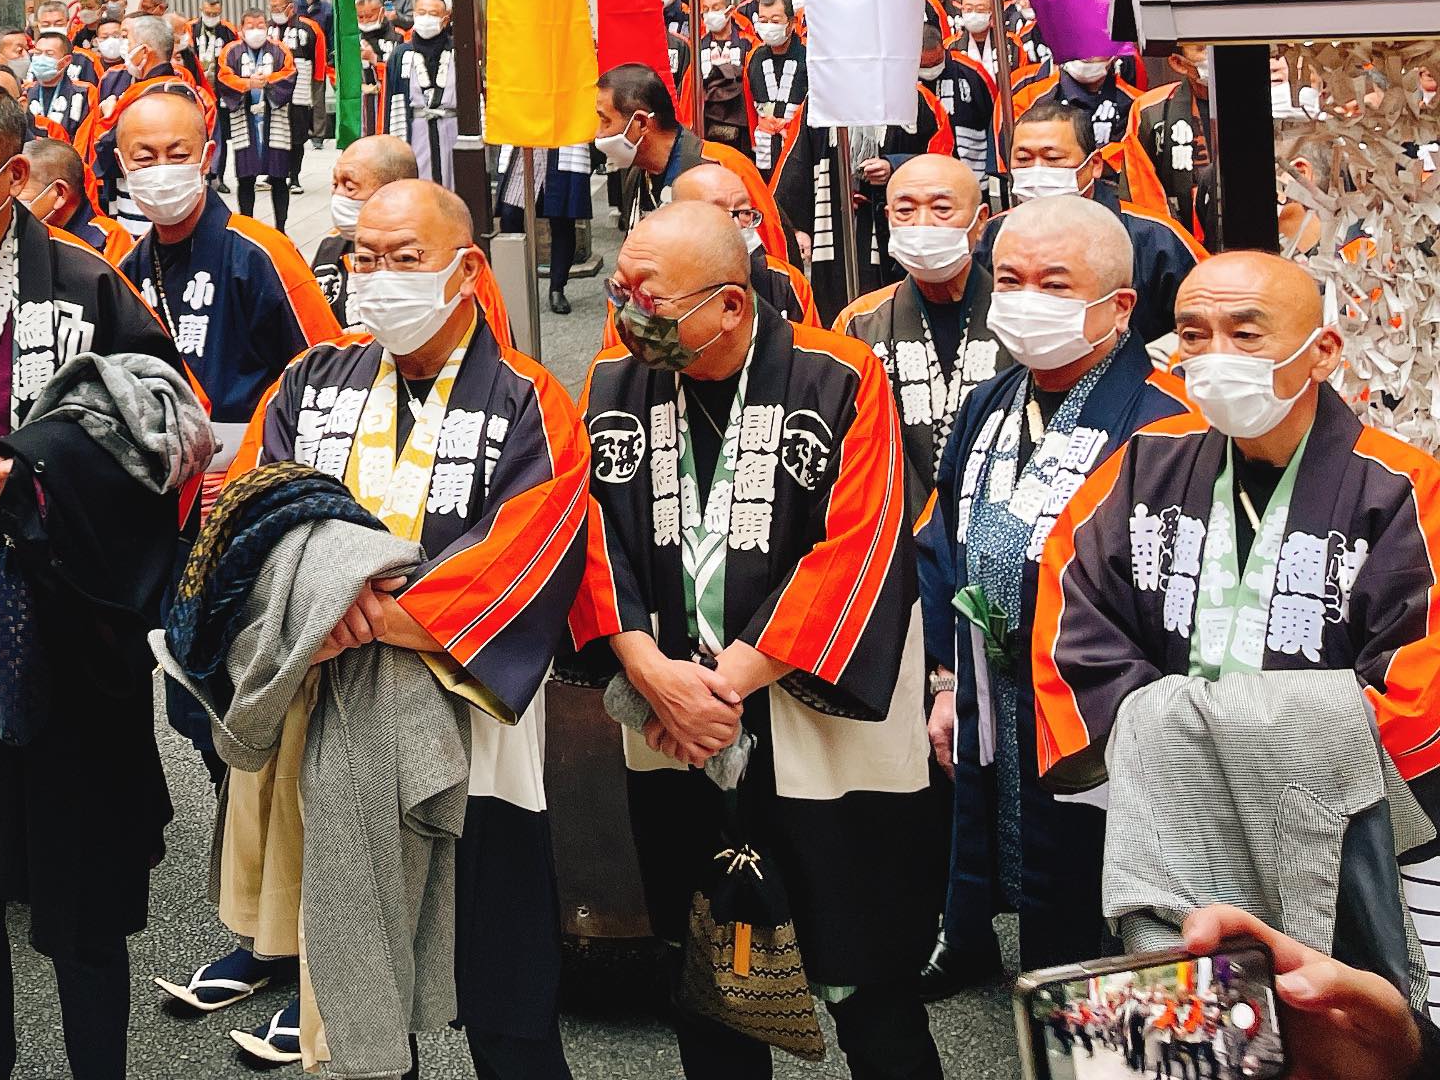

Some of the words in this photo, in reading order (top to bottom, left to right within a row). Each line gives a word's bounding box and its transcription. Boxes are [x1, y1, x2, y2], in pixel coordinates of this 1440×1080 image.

[17, 300, 55, 401] 組頭
[170, 270, 215, 358] 小頭
[896, 340, 933, 425] 組頭
[426, 408, 485, 518] 組頭
[650, 400, 680, 547] 副組頭
[728, 403, 785, 554] 副組頭
[1163, 515, 1206, 639] 組頭
[1266, 531, 1330, 662] 組頭
